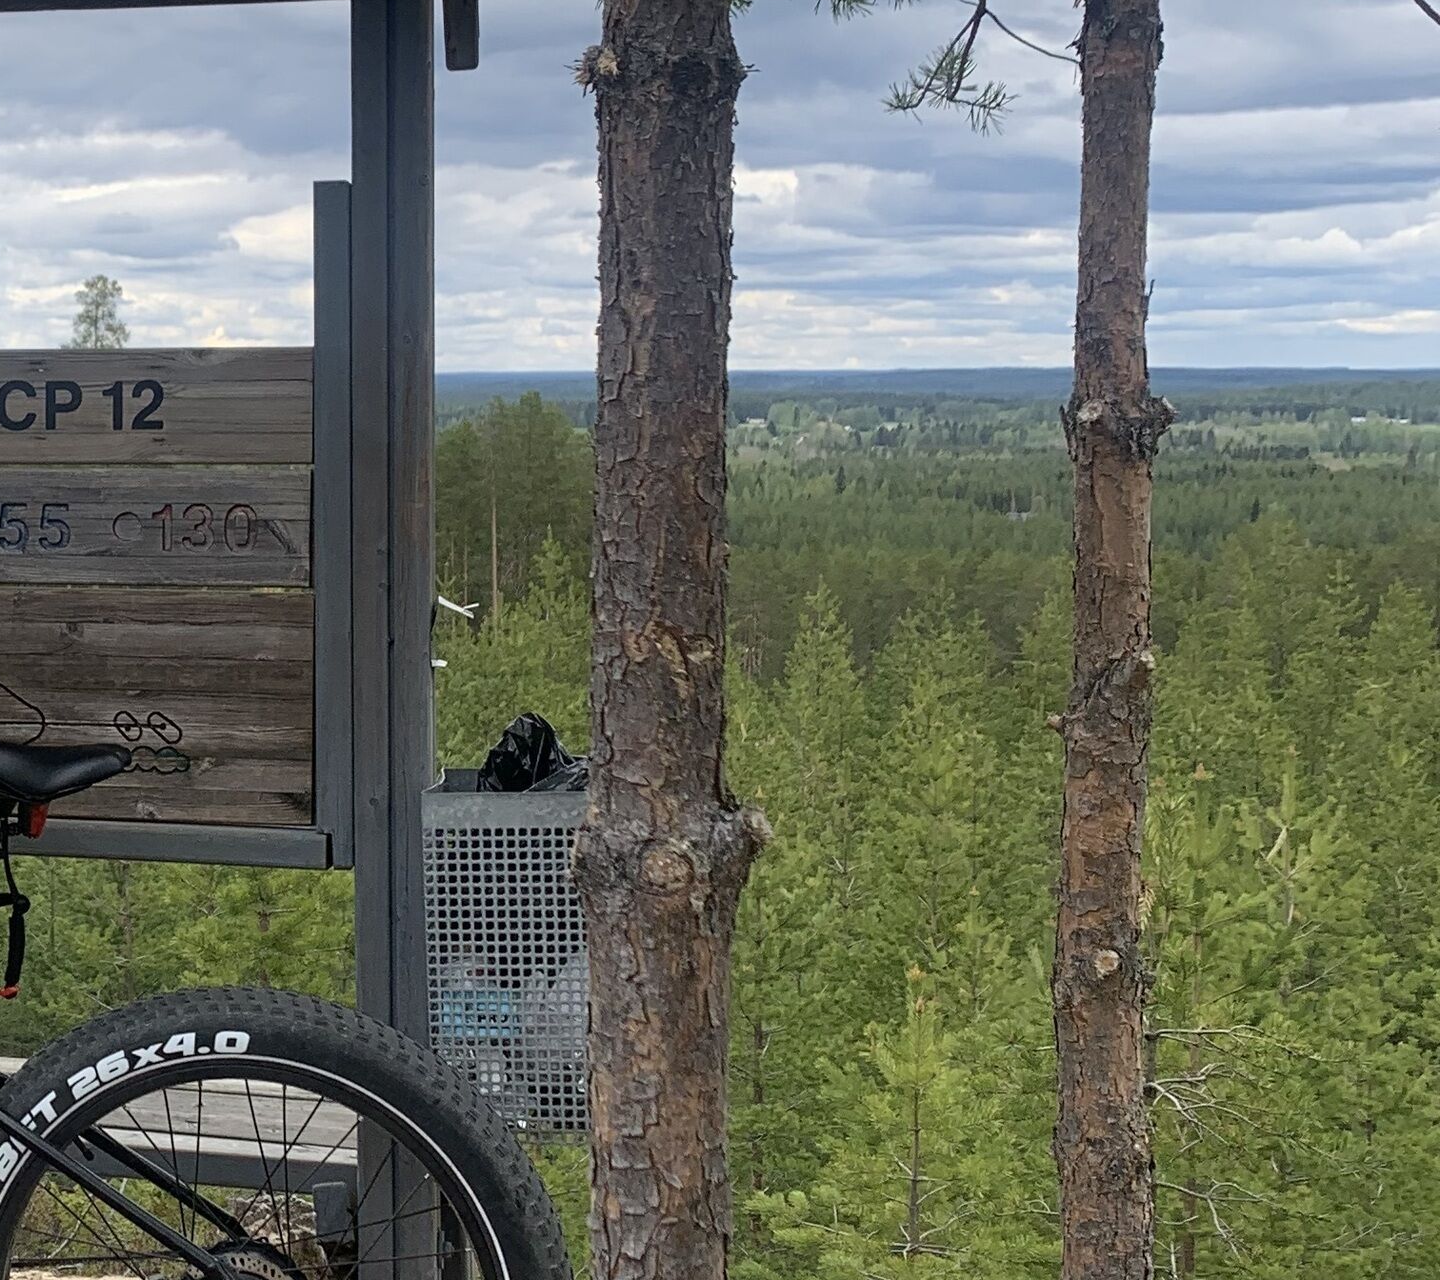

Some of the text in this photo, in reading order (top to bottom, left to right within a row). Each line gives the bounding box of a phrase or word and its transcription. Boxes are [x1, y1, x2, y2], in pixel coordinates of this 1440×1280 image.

[102, 379, 165, 431] 12
[151, 502, 259, 554] 130
[66, 1030, 251, 1101] 26x4.0
